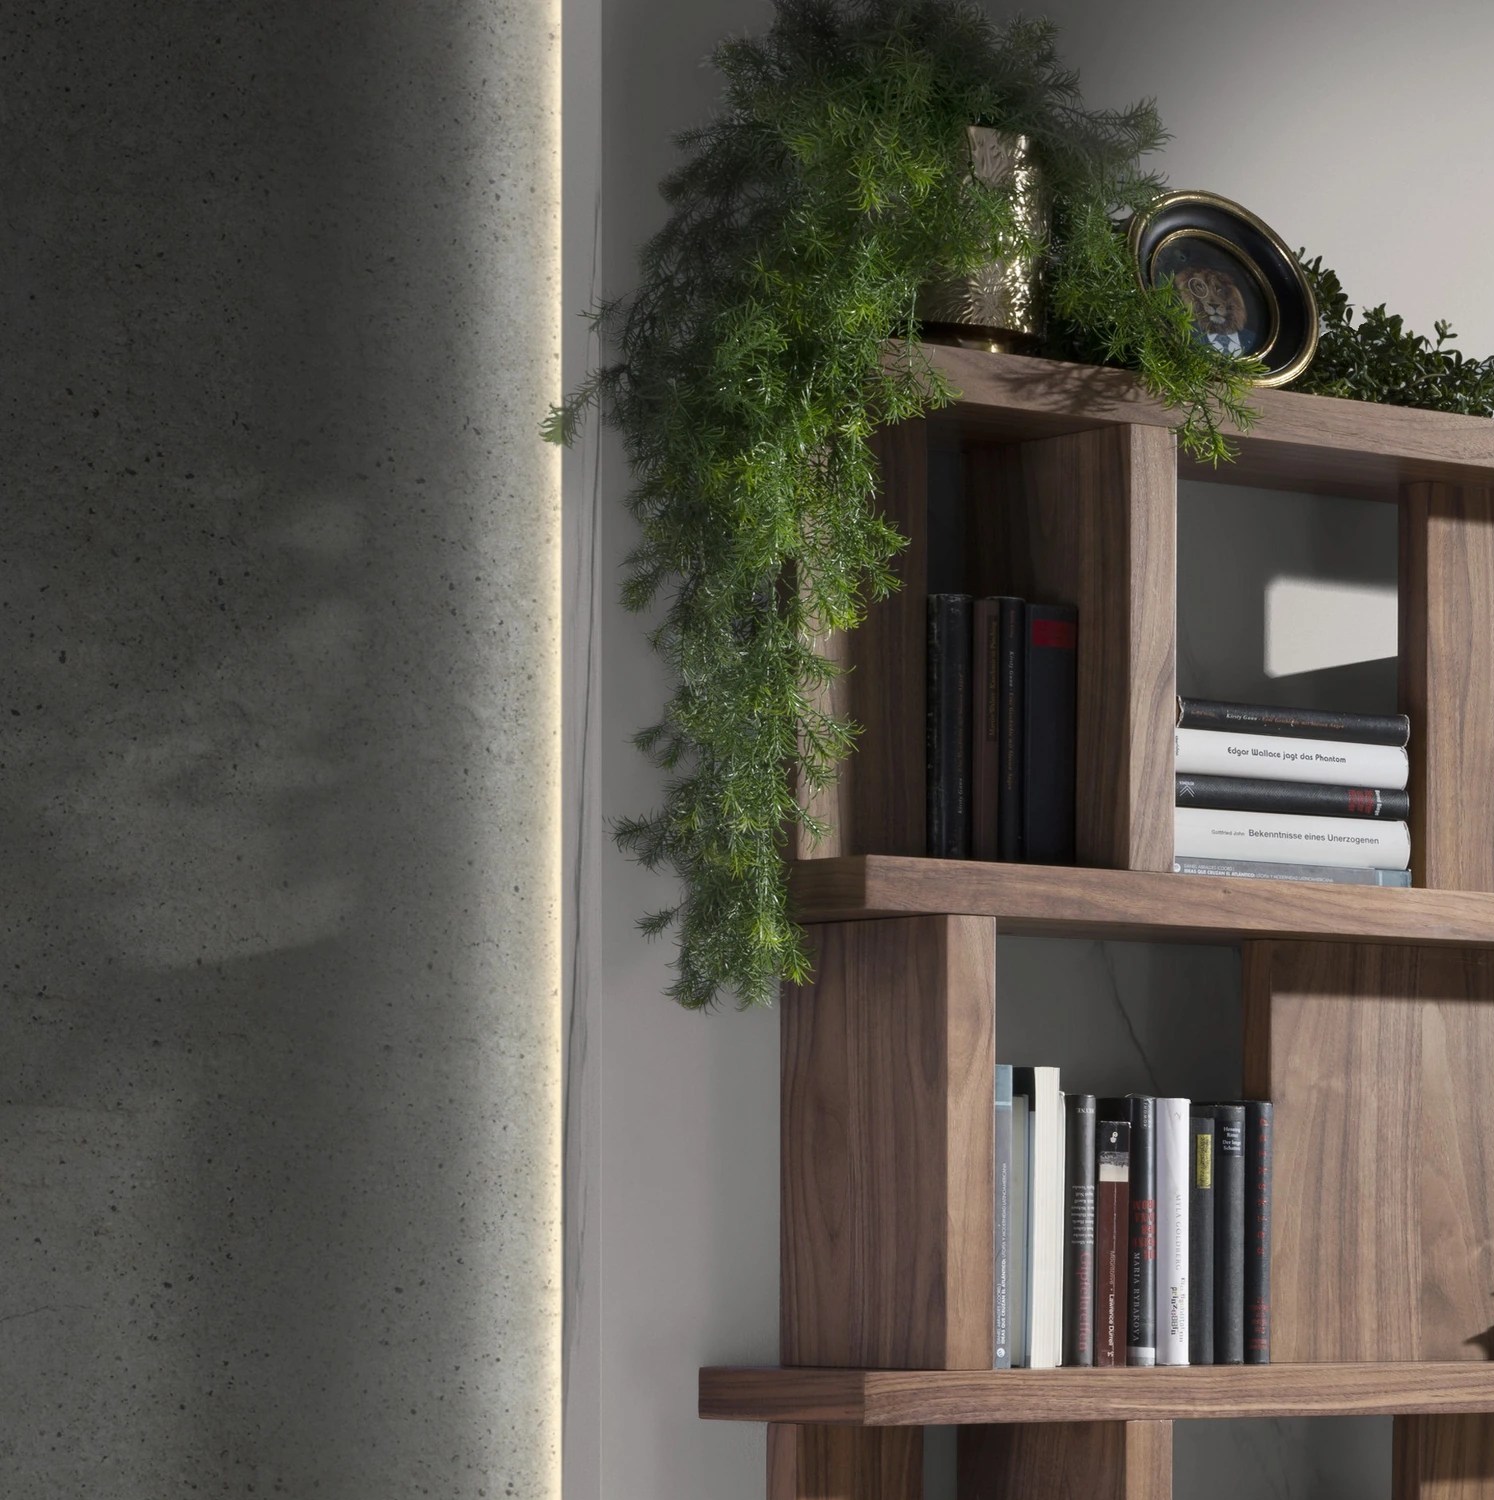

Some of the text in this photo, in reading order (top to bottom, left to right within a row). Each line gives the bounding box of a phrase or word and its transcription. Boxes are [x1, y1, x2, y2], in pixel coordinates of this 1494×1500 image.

[1227, 746, 1346, 764] Edgar Wallace jagt das Phantom
[1248, 829, 1302, 841] Bekenntnisse
[1304, 832, 1326, 842] eines
[1327, 834, 1380, 845] Unerzogenen
[1132, 1288, 1140, 1342] RYBAKOVA
